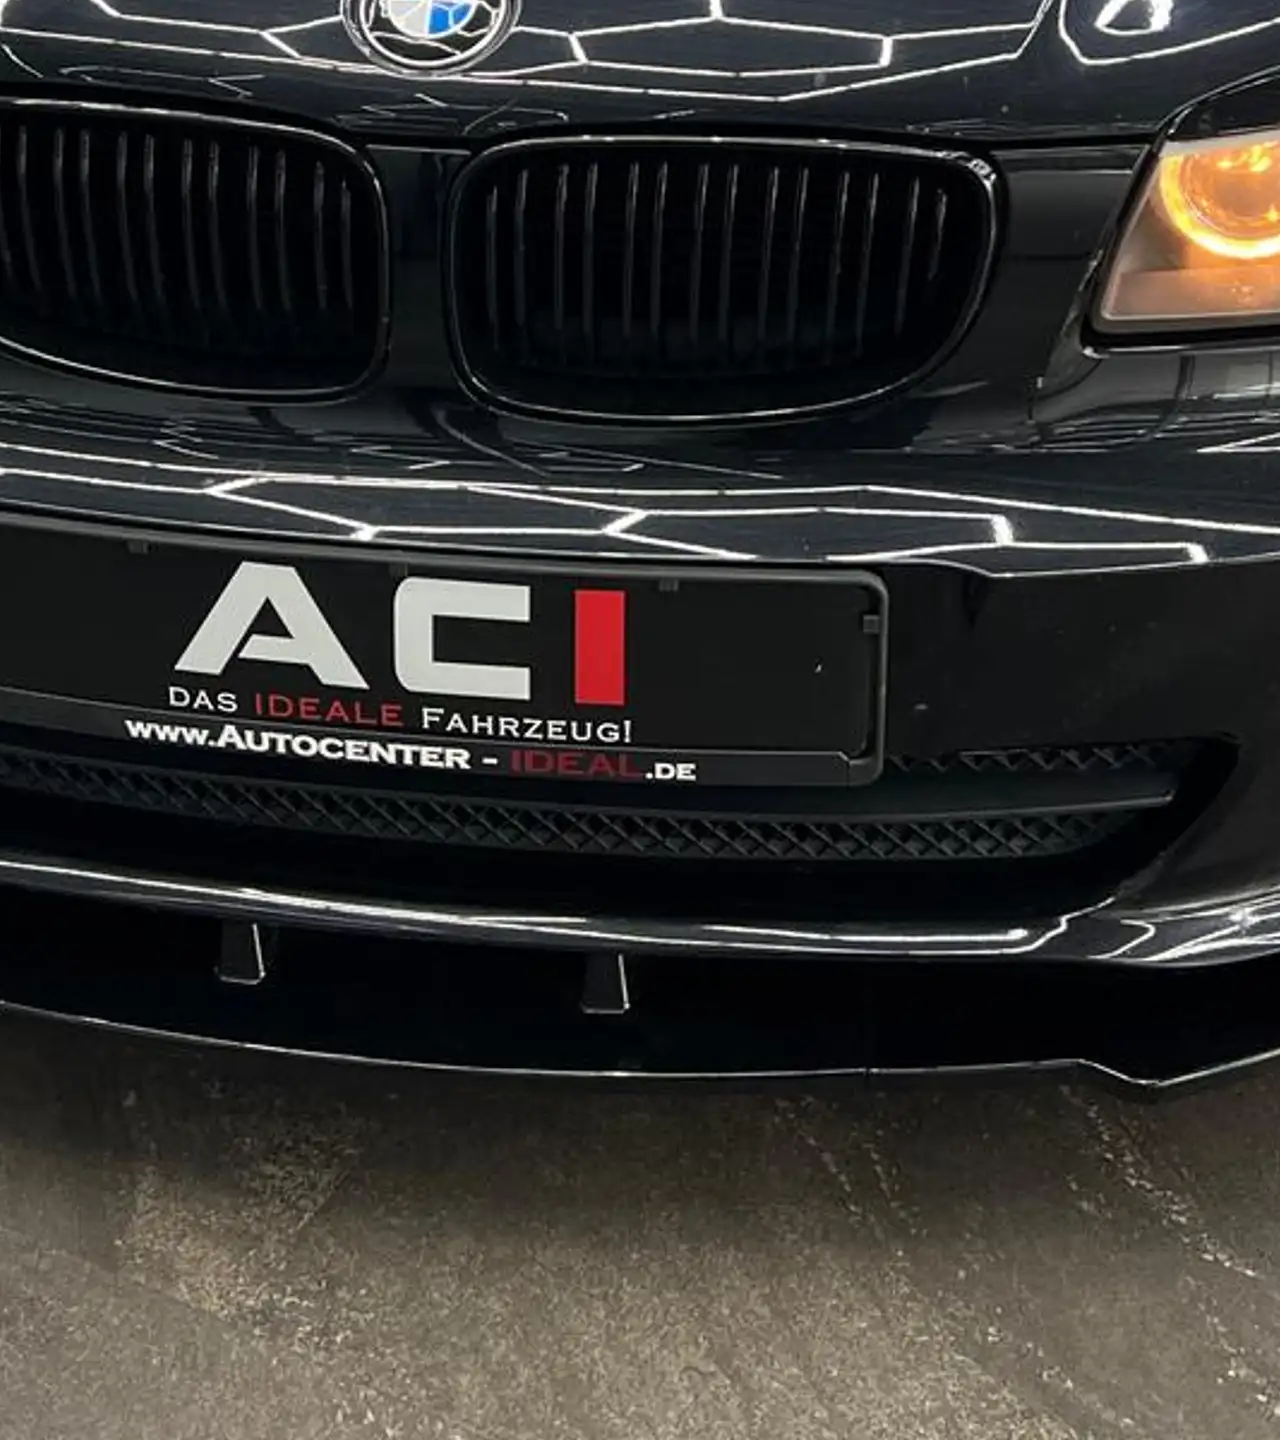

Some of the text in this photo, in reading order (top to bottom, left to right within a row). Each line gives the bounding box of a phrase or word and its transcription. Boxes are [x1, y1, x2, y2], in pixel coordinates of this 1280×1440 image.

[174, 561, 625, 705] ACI
[169, 686, 632, 743] DAS IDEALE FAHRZEUG!
